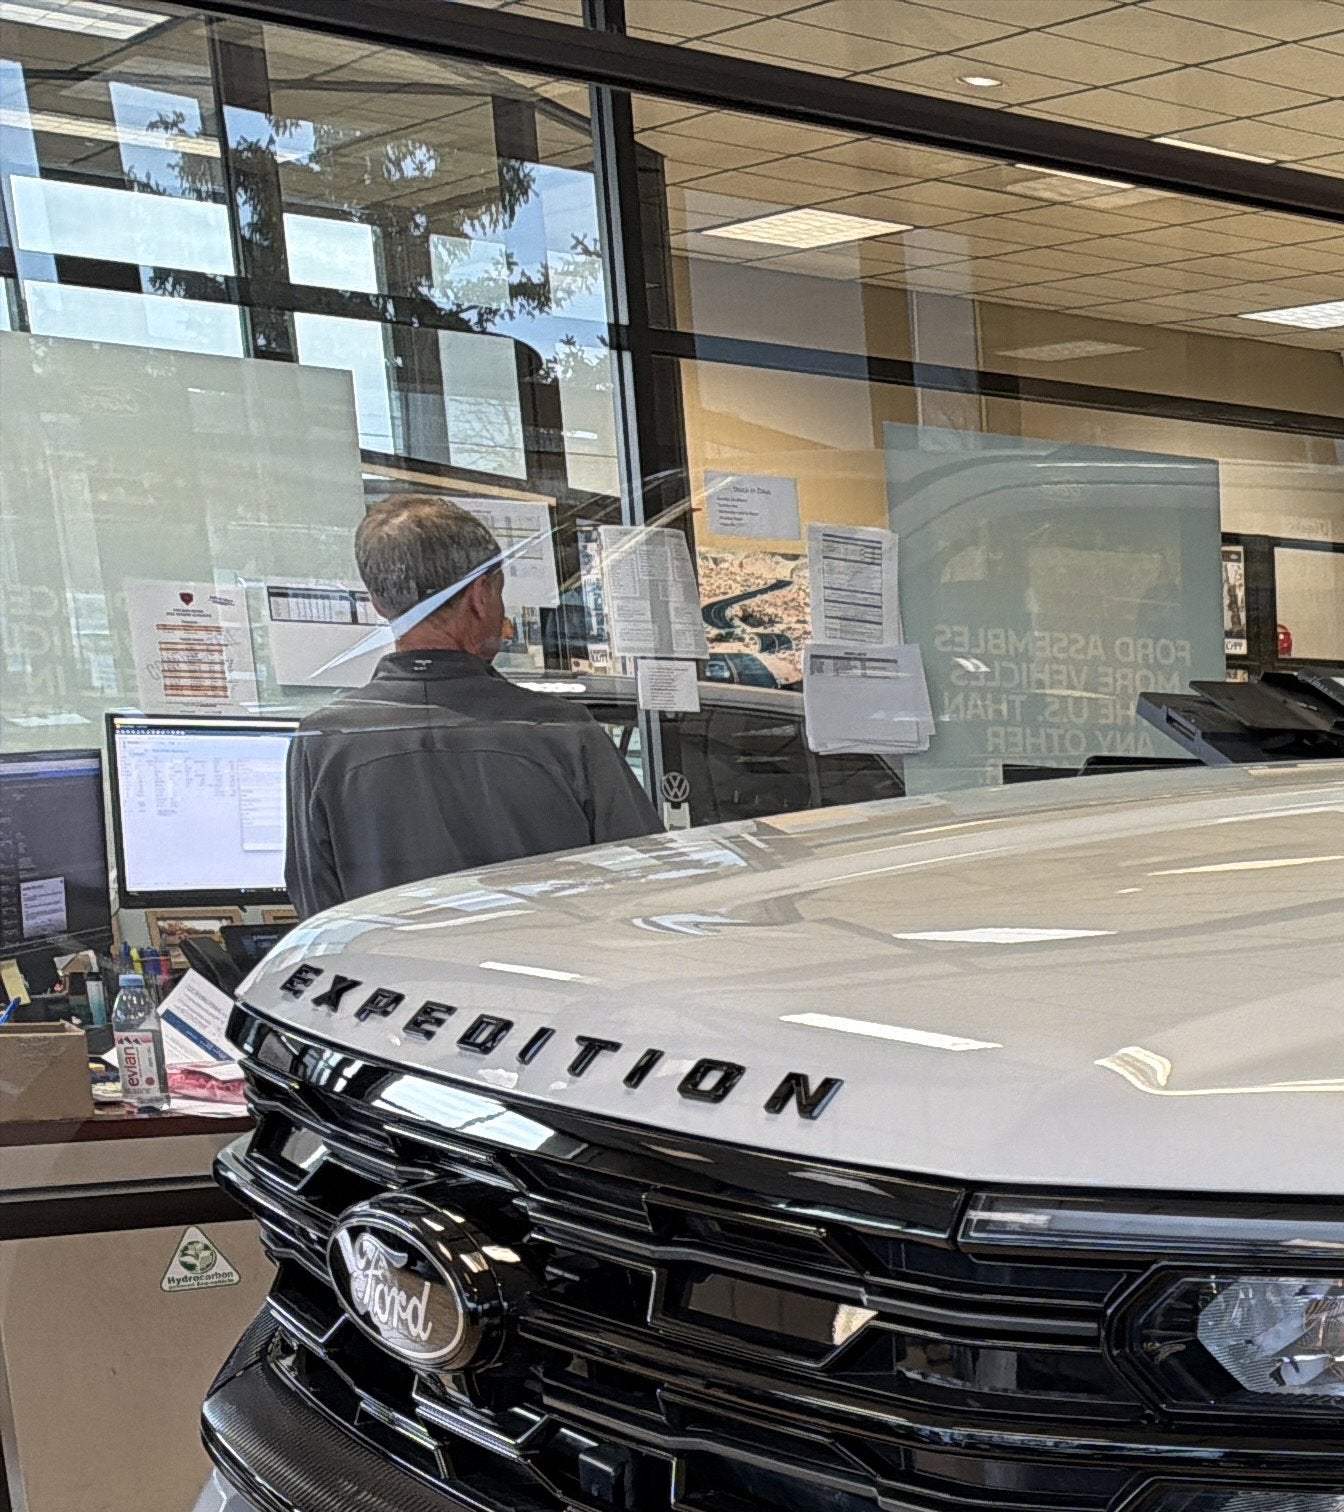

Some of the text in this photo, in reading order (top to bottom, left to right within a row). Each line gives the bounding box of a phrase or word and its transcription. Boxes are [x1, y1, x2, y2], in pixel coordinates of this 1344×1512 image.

[122, 1045, 140, 1088] evian
[279, 962, 845, 1121] EXPEDITION
[167, 1271, 234, 1286] Hydrocarbon
[349, 1231, 433, 1341] Ford
